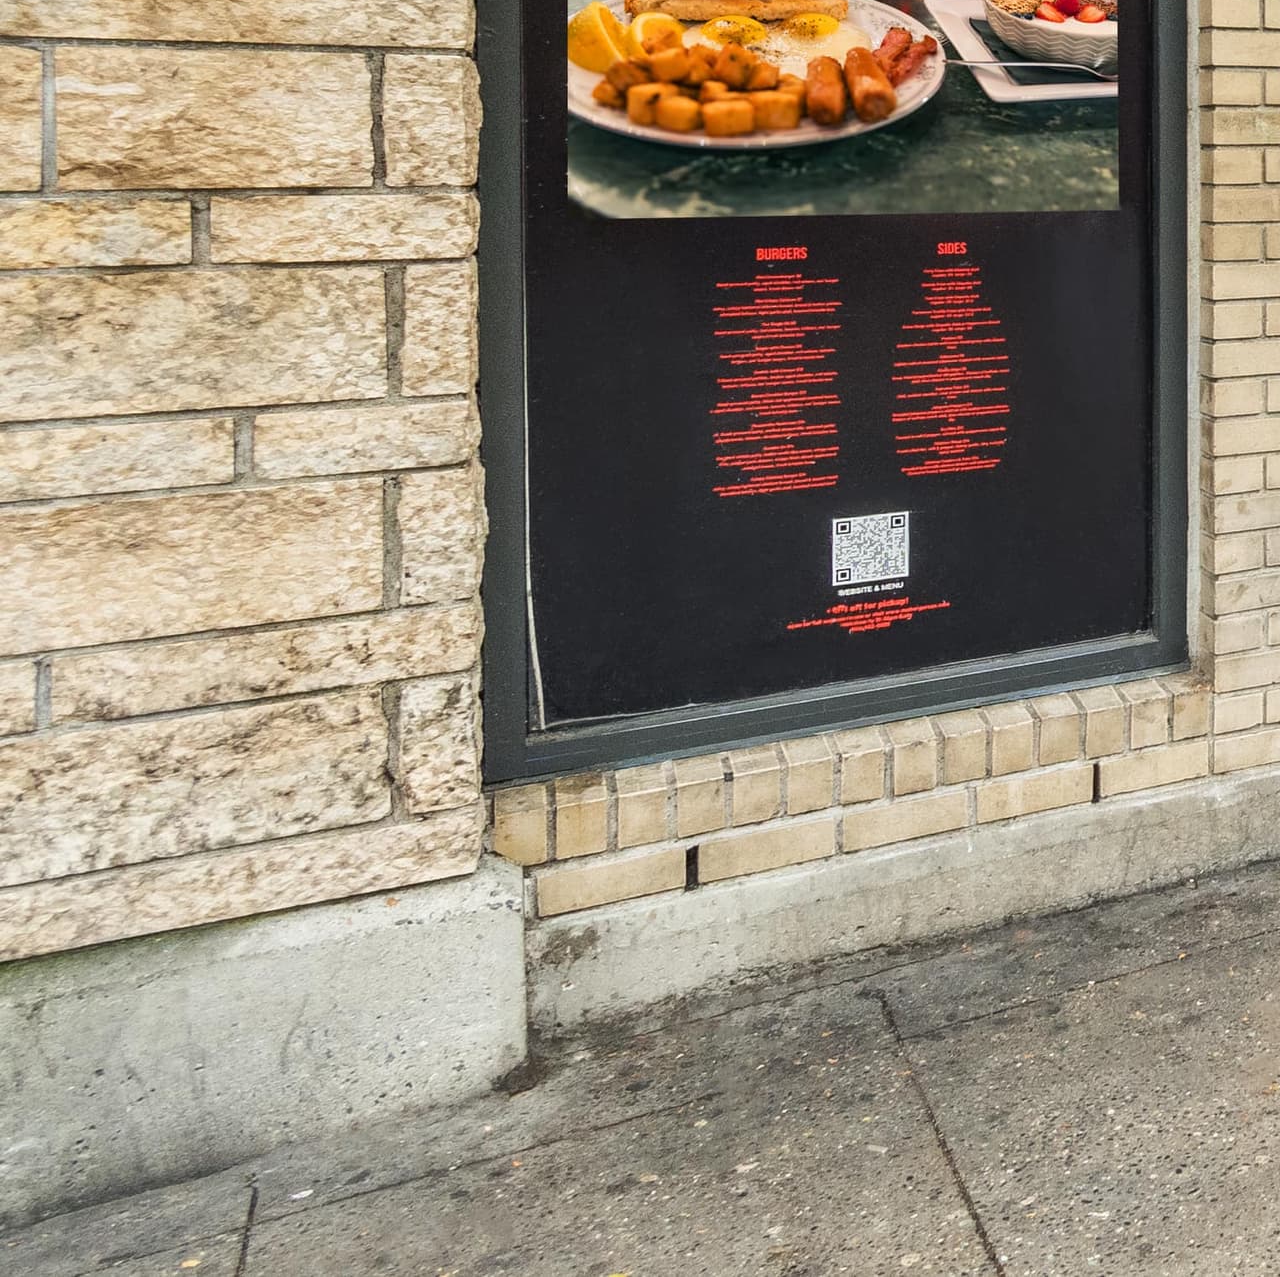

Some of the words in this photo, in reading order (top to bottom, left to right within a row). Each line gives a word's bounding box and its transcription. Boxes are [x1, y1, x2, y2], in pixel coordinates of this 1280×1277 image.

[756, 247, 808, 261] BURGERS
[937, 242, 967, 255] SIDES
[881, 581, 904, 590] MENU
